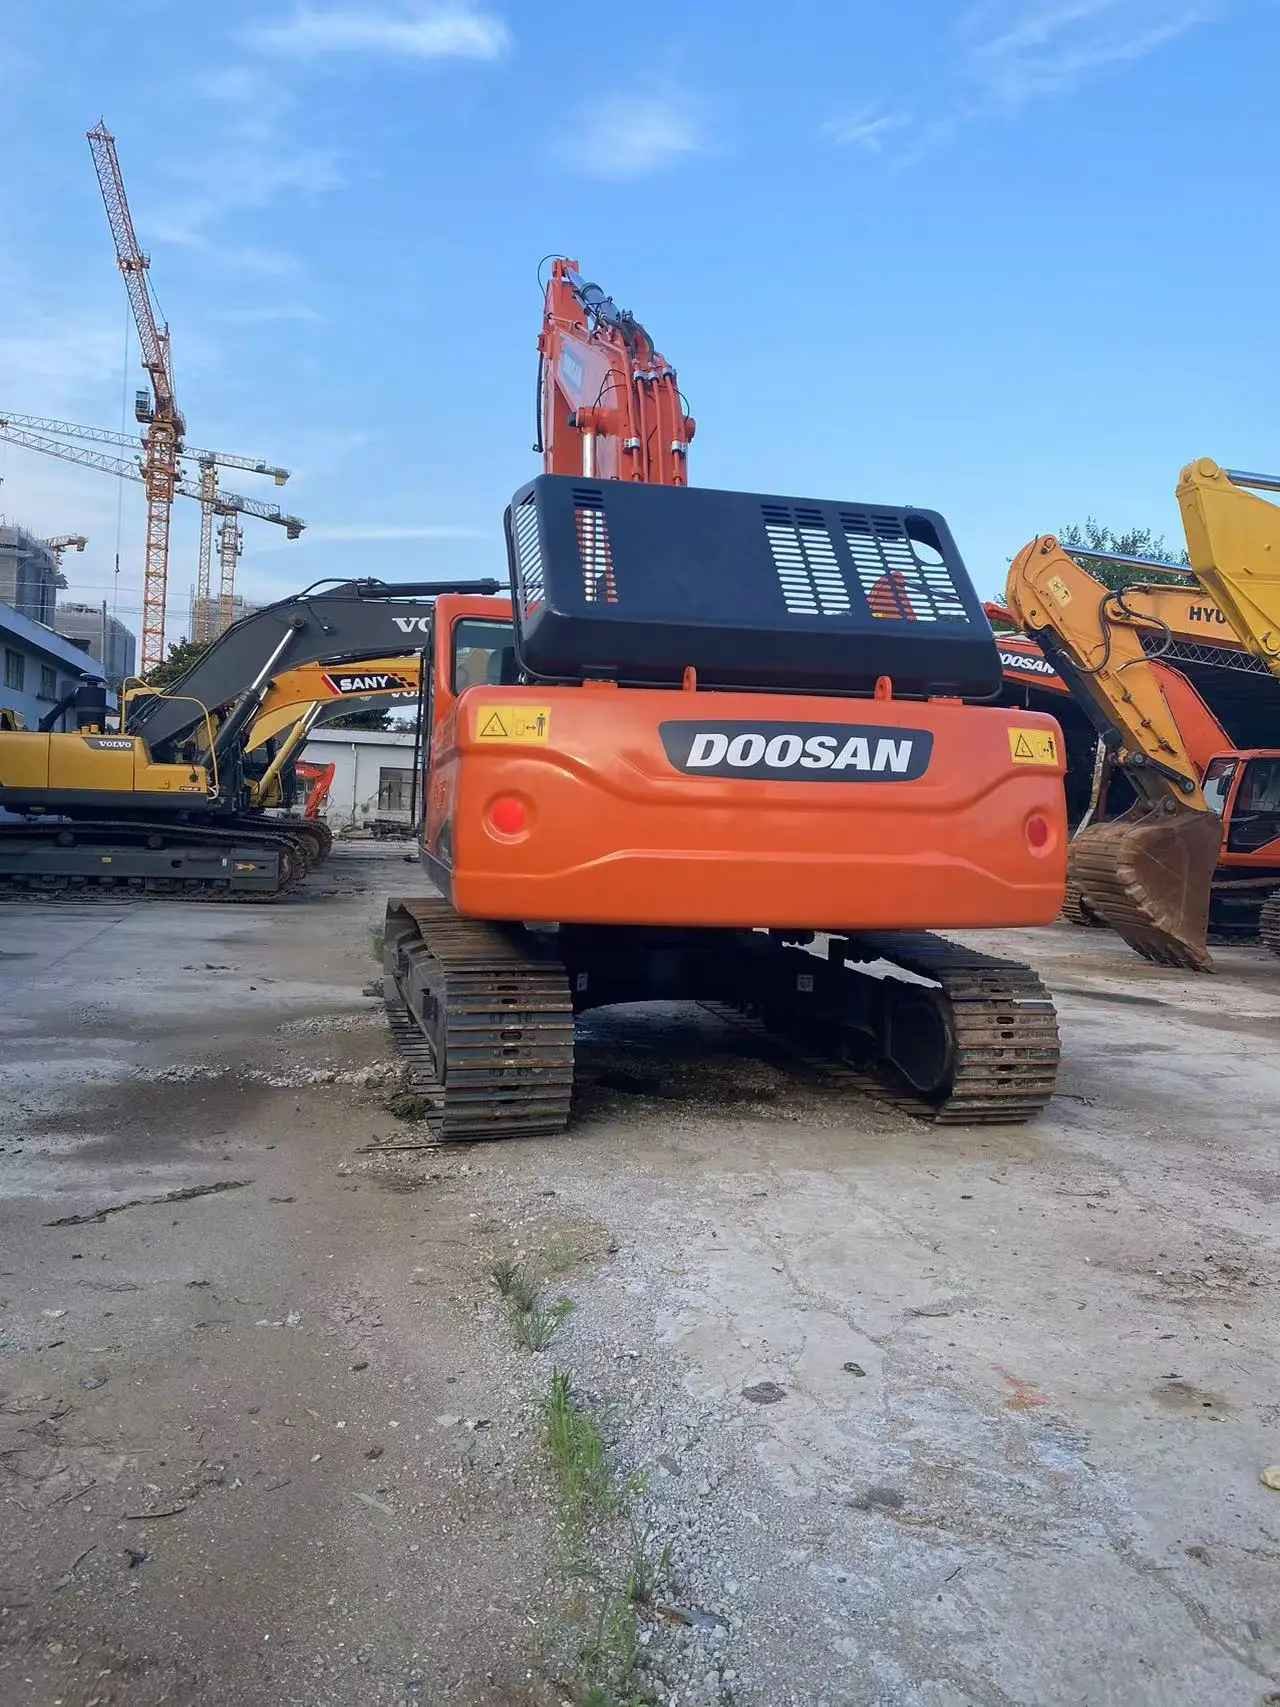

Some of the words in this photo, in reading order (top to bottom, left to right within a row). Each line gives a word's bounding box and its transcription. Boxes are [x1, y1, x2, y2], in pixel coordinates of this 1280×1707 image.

[340, 676, 388, 691] SANY
[99, 740, 132, 748] VOLVO
[686, 733, 913, 773] DOOSAN
